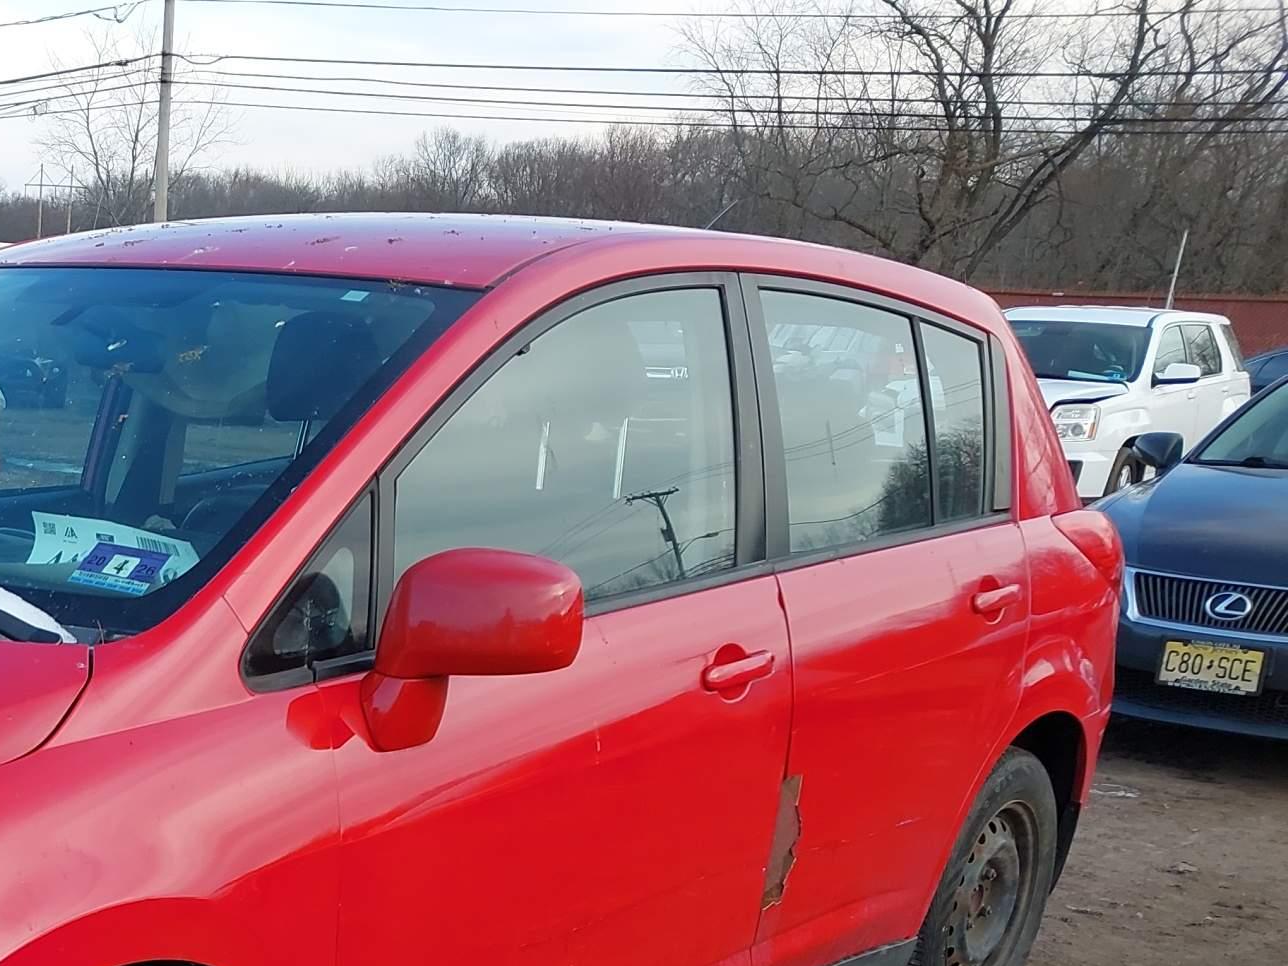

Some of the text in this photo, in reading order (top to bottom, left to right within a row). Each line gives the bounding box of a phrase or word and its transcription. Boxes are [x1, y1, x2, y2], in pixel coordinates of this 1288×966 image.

[87, 555, 106, 566] 20
[113, 559, 129, 574] 4
[136, 564, 155, 576] 26
[1164, 650, 1257, 682] C80 SCE
